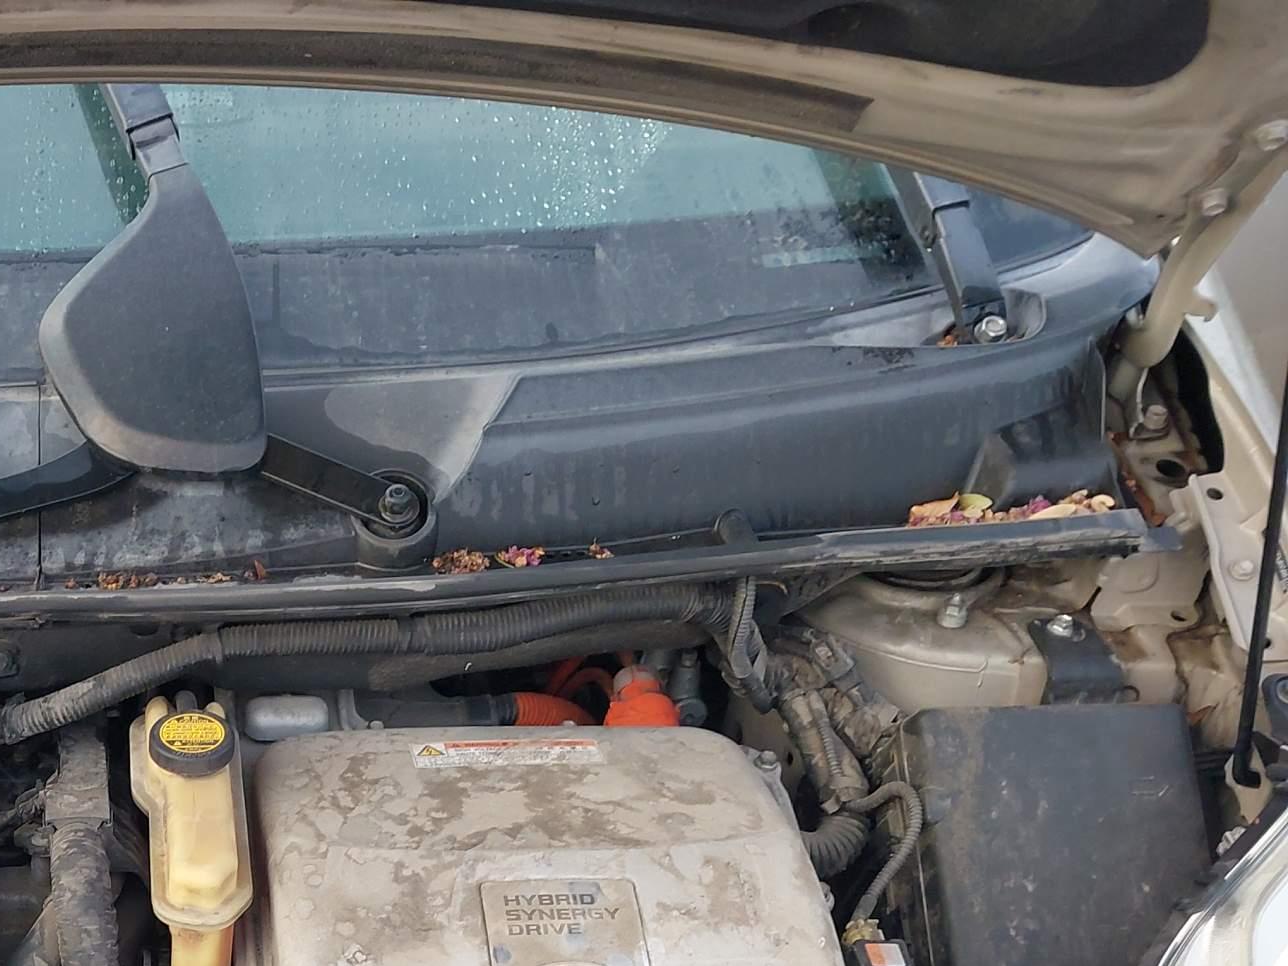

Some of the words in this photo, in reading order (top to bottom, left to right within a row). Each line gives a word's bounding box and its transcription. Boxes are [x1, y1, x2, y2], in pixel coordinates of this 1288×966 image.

[503, 893, 596, 907] HYBRID
[505, 907, 620, 921] SYNERGY
[508, 922, 583, 936] DRIVE
